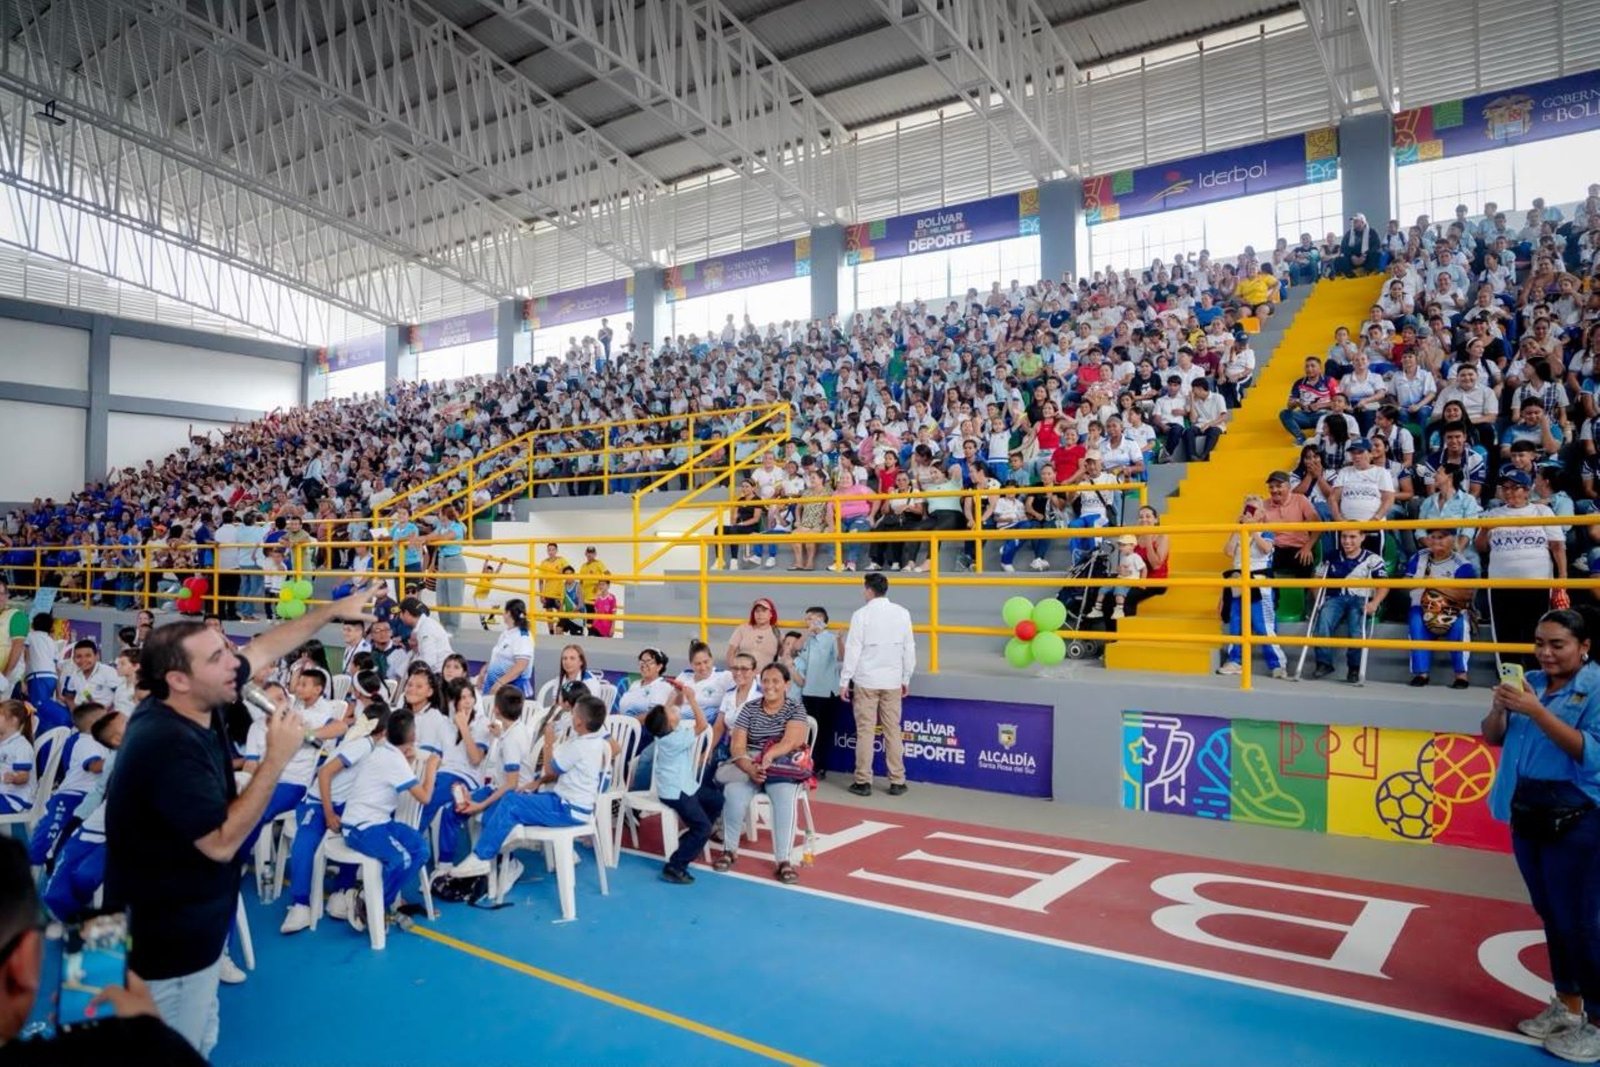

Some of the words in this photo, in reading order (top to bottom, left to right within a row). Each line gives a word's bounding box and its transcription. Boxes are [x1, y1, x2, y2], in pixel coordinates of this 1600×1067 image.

[1198, 159, 1267, 189] Iderbol
[916, 212, 963, 229] BOLÍVAR
[908, 230, 973, 253] DEPORTE
[1492, 536, 1546, 546] MAYOR
[903, 719, 955, 737] BOLÍVAR
[917, 734, 942, 744] MEJOR
[979, 750, 1037, 768] ALCALDÍA
[979, 761, 996, 770] Santa
[997, 763, 1012, 772] Rosa
